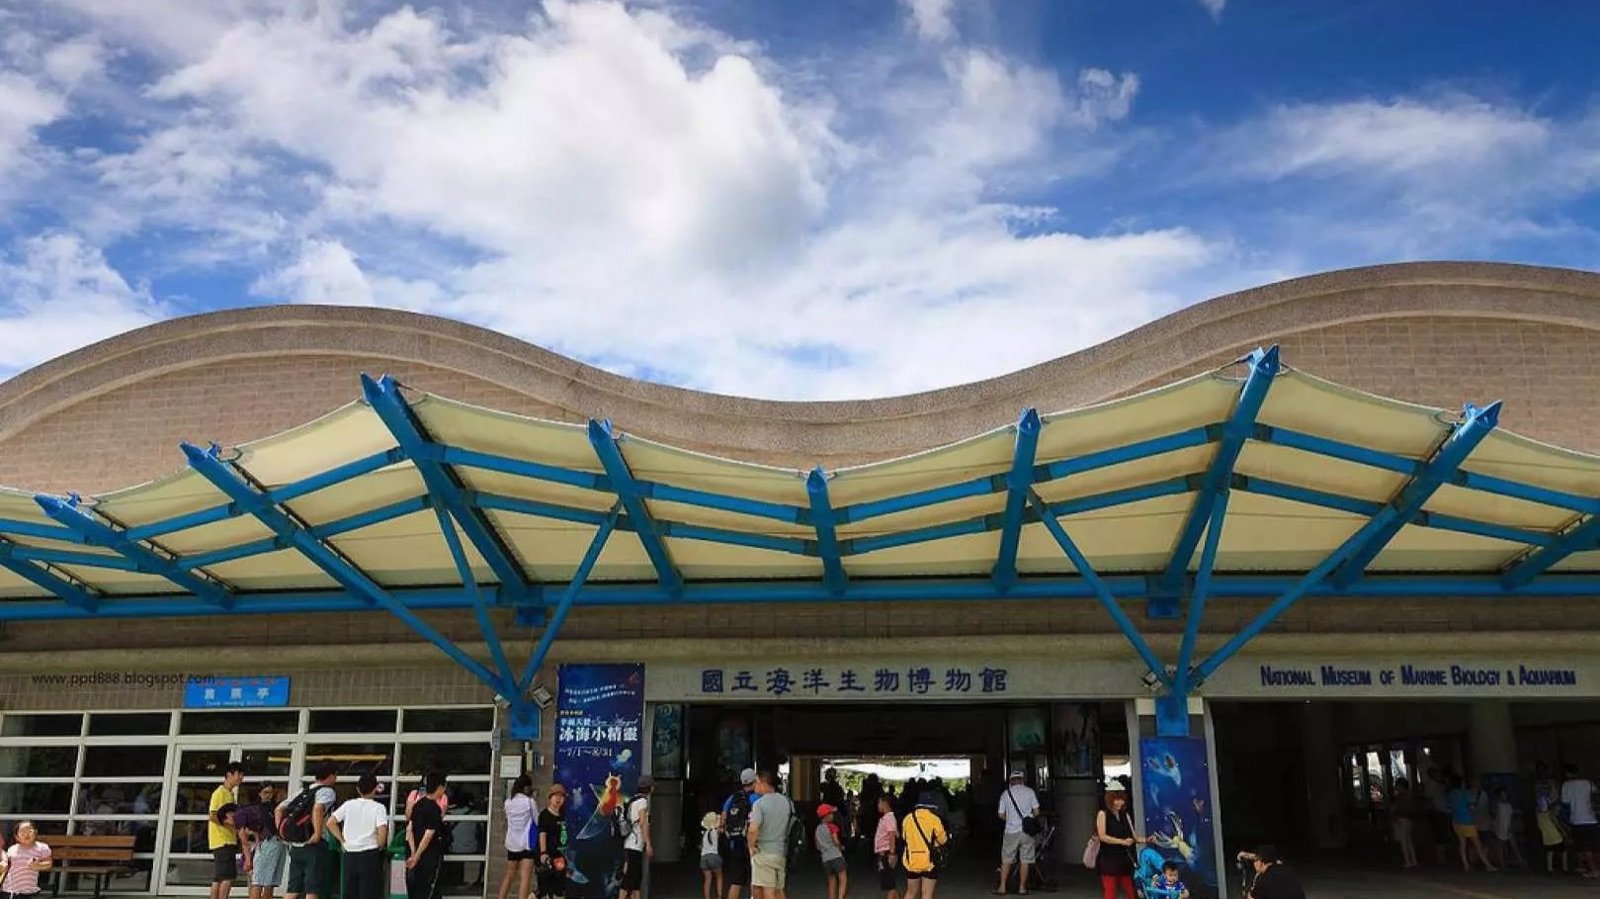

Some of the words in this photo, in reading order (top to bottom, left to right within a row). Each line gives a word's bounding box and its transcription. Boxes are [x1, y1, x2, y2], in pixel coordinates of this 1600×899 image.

[702, 667, 1007, 694] 國立海洋生物博物館
[1379, 670, 1395, 685] OF
